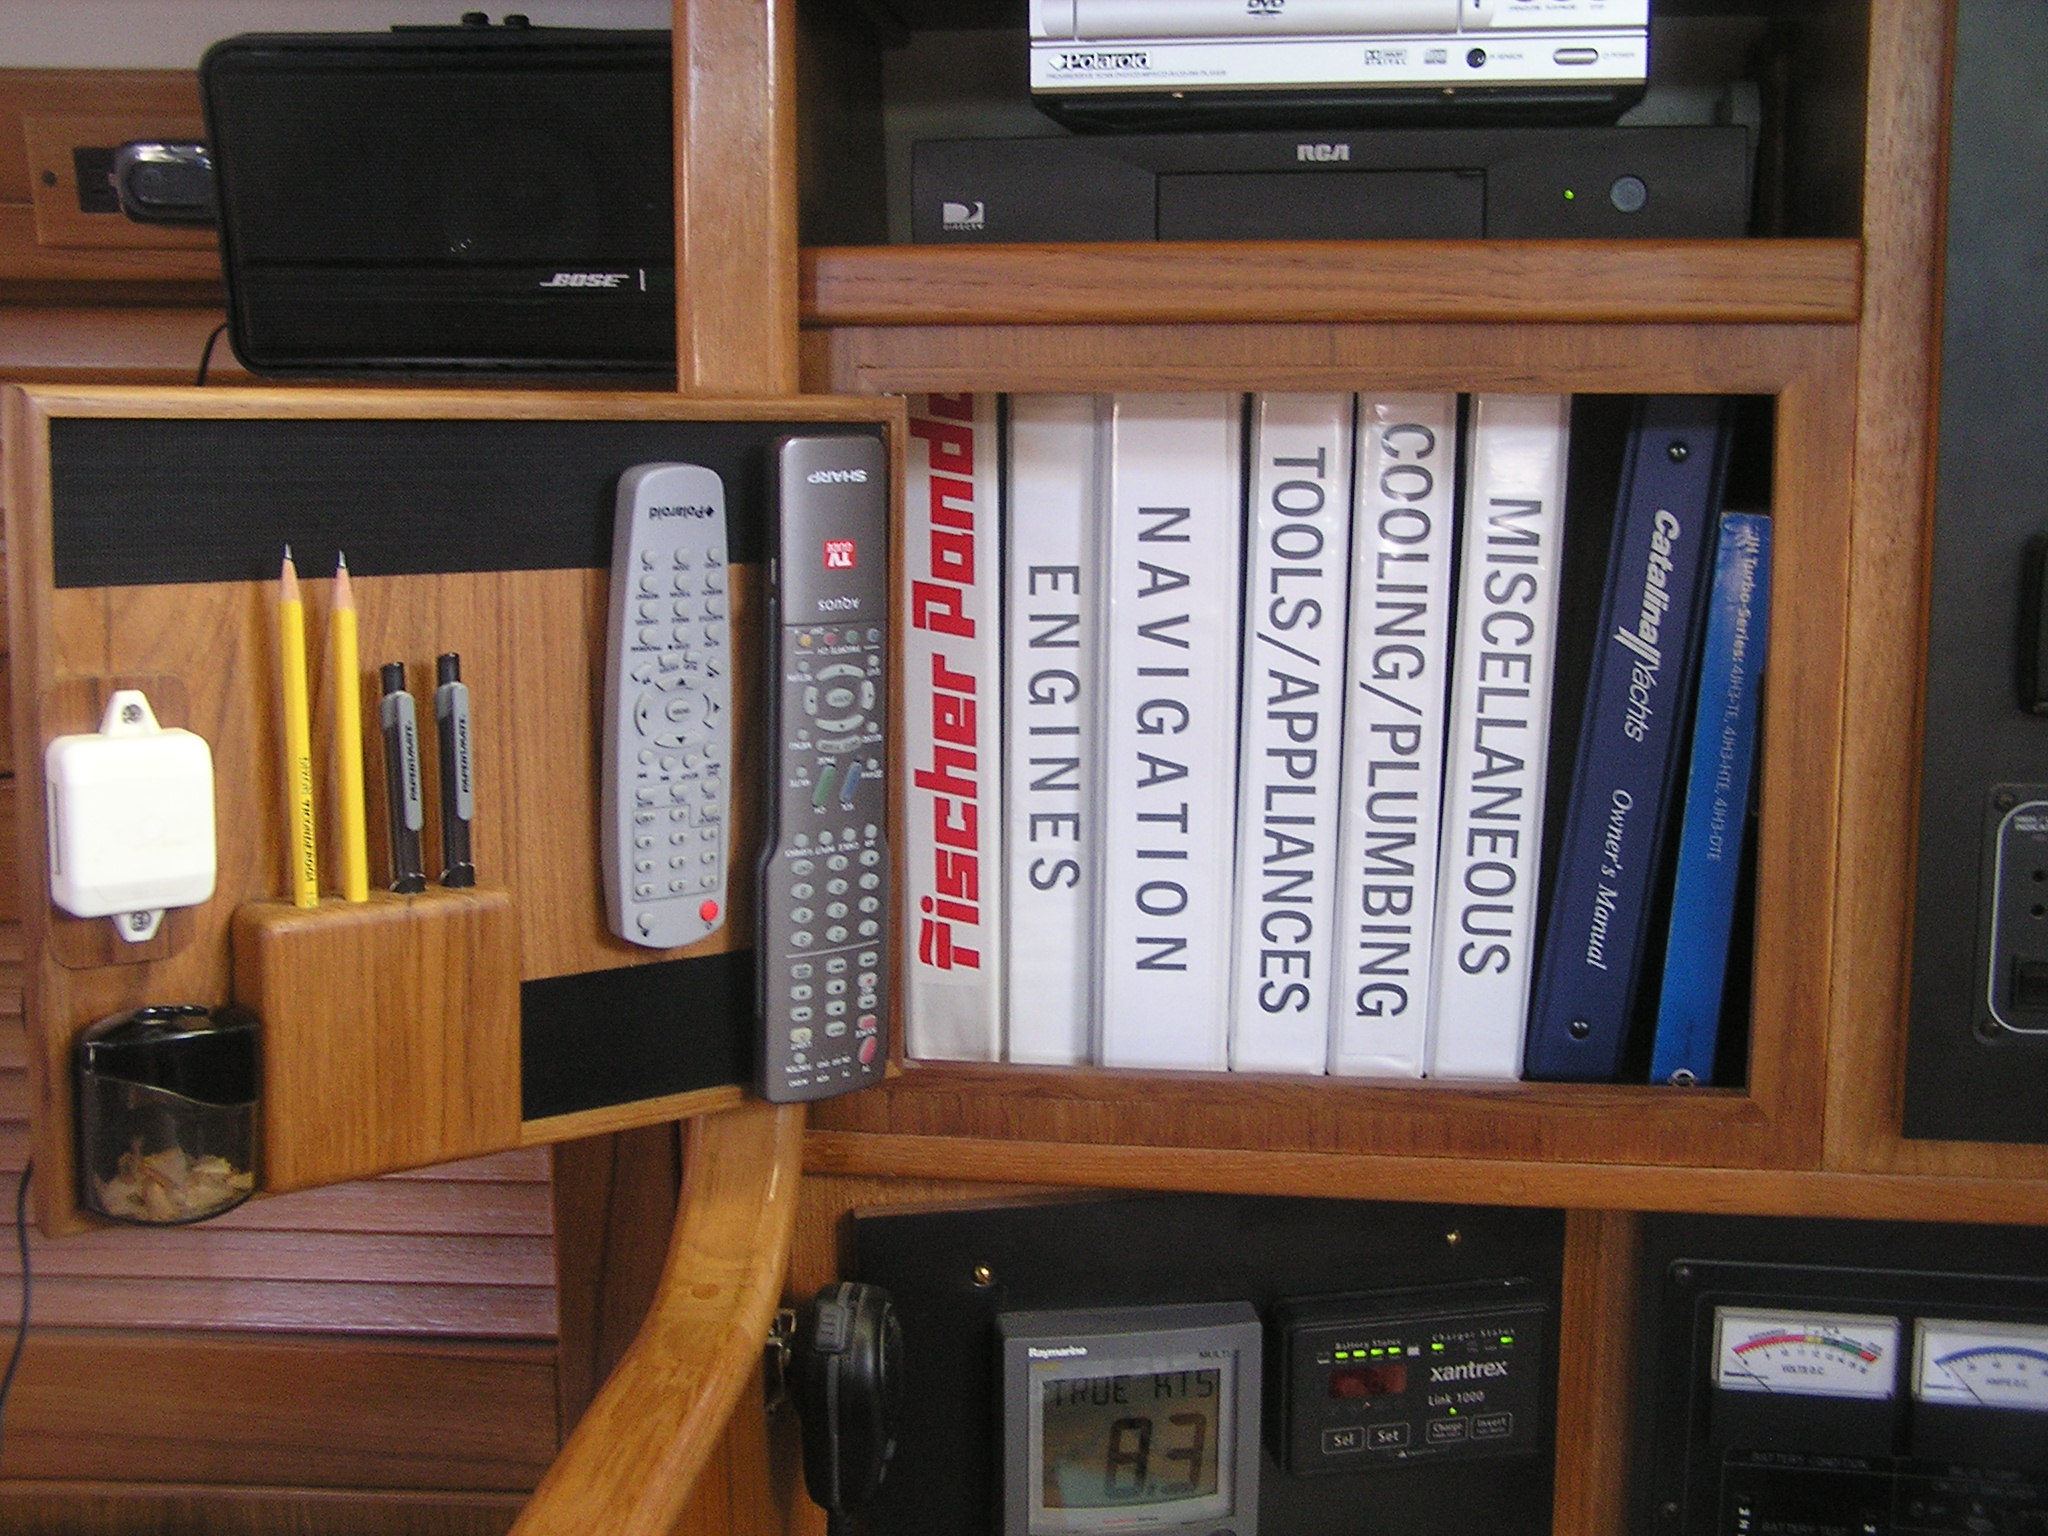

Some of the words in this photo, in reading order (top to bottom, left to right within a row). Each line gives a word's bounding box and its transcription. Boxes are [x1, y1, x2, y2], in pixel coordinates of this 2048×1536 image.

[1065, 51, 1151, 70] Polaroid
[1297, 144, 1350, 161] RCA
[539, 273, 630, 288] BOSE
[807, 469, 868, 483] SHARP
[648, 506, 705, 520] Polaroid
[828, 552, 853, 568] TV
[1637, 509, 1682, 645] Catalina
[818, 596, 861, 611] AQUOS
[1623, 660, 1659, 742] Yachts
[1029, 565, 1081, 891] ENGINES
[1257, 446, 1326, 1014] TOOLS/APPLIANCES
[1355, 422, 1436, 1018] COOLING/PLUMBING
[1135, 506, 1191, 972] NAVIGATION
[1457, 497, 1543, 976] MISCELLANEOUS
[914, 652, 981, 970] Fischer
[1601, 788, 1634, 878] Owner's
[1585, 883, 1619, 971] Manual
[1430, 1360, 1509, 1382] xantrex
[1053, 1376, 1129, 1405] TRUE
[1428, 1393, 1453, 1407] Link
[1456, 1389, 1486, 1403] 1000
[1377, 1430, 1400, 1443] Set
